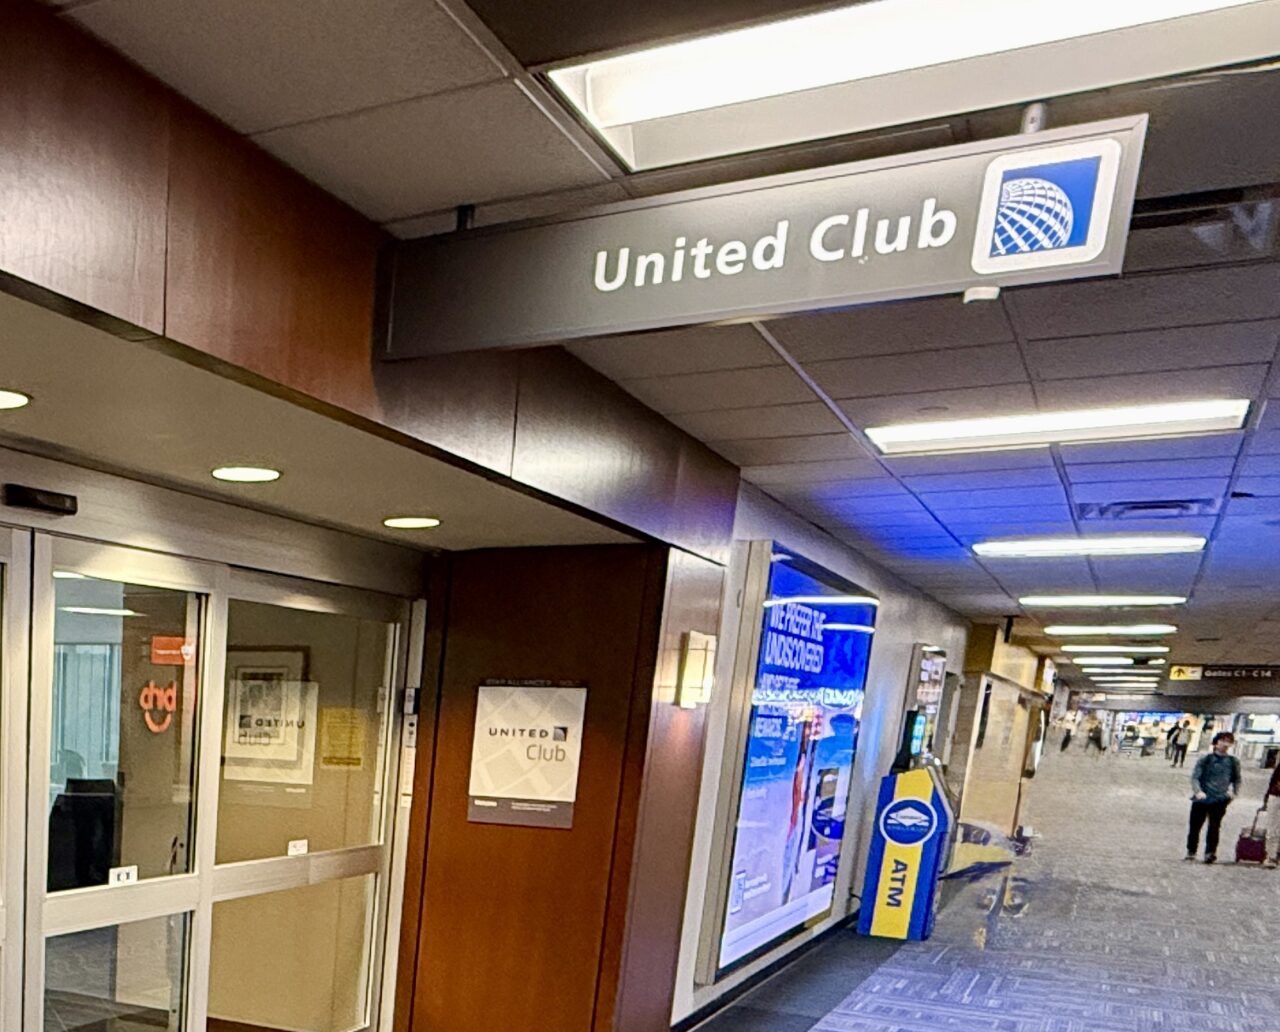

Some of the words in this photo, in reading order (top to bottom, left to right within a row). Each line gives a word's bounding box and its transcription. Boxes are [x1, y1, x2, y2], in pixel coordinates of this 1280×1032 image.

[594, 220, 789, 291] United
[810, 198, 957, 261] Club
[489, 728, 549, 738] UNITED
[526, 744, 566, 762] Club
[886, 858, 908, 908] ATM
